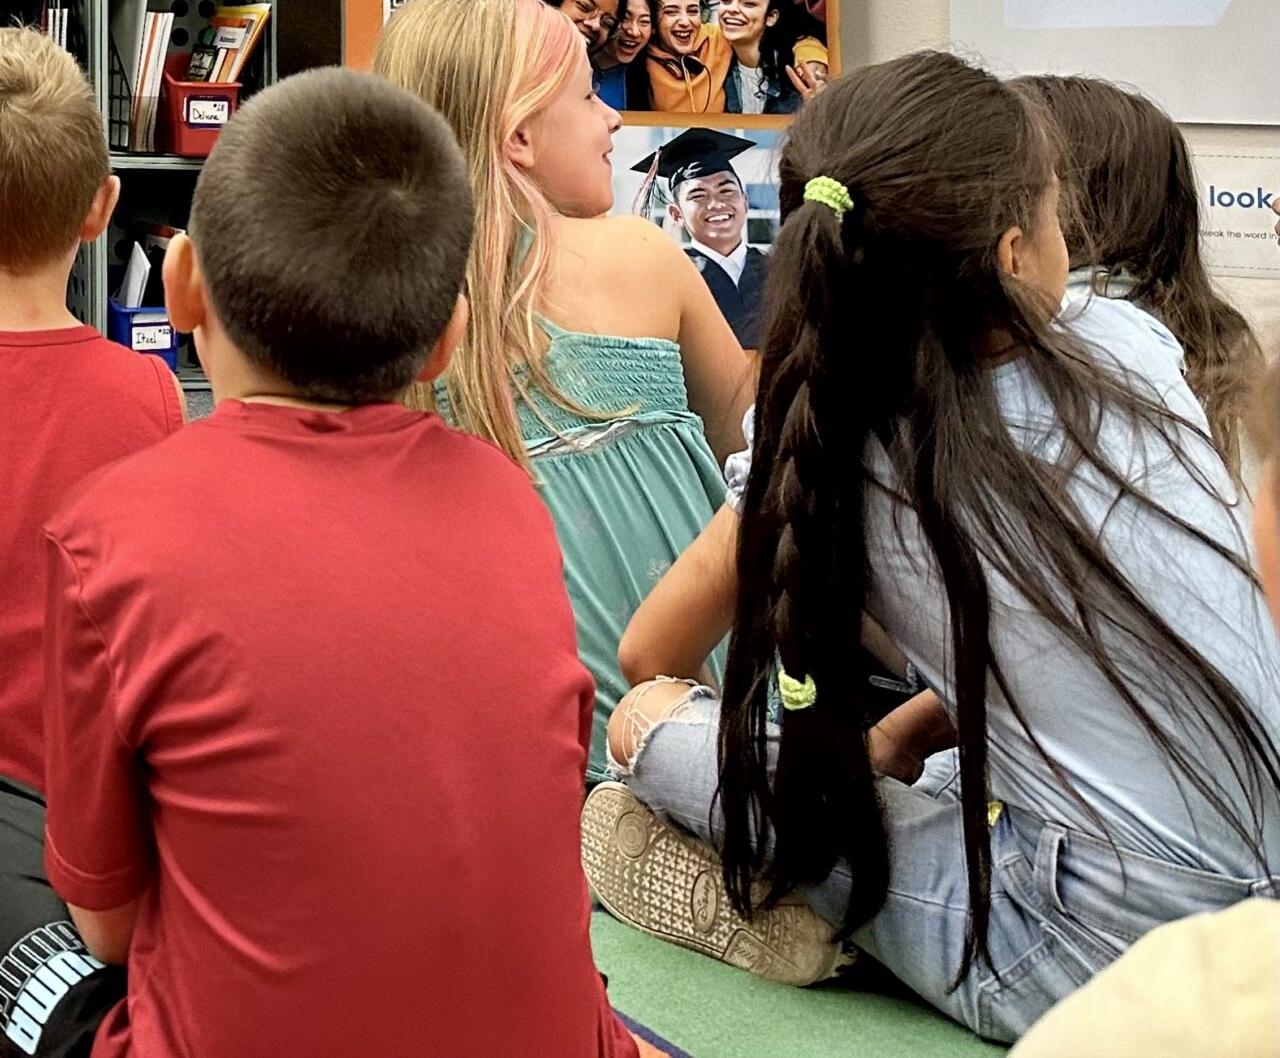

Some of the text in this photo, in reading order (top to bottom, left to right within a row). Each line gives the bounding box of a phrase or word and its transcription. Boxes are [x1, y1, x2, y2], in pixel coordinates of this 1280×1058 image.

[1209, 185, 1273, 209] look
[1201, 229, 1224, 238] reak
[1227, 230, 1241, 238] the
[1244, 231, 1267, 239] word
